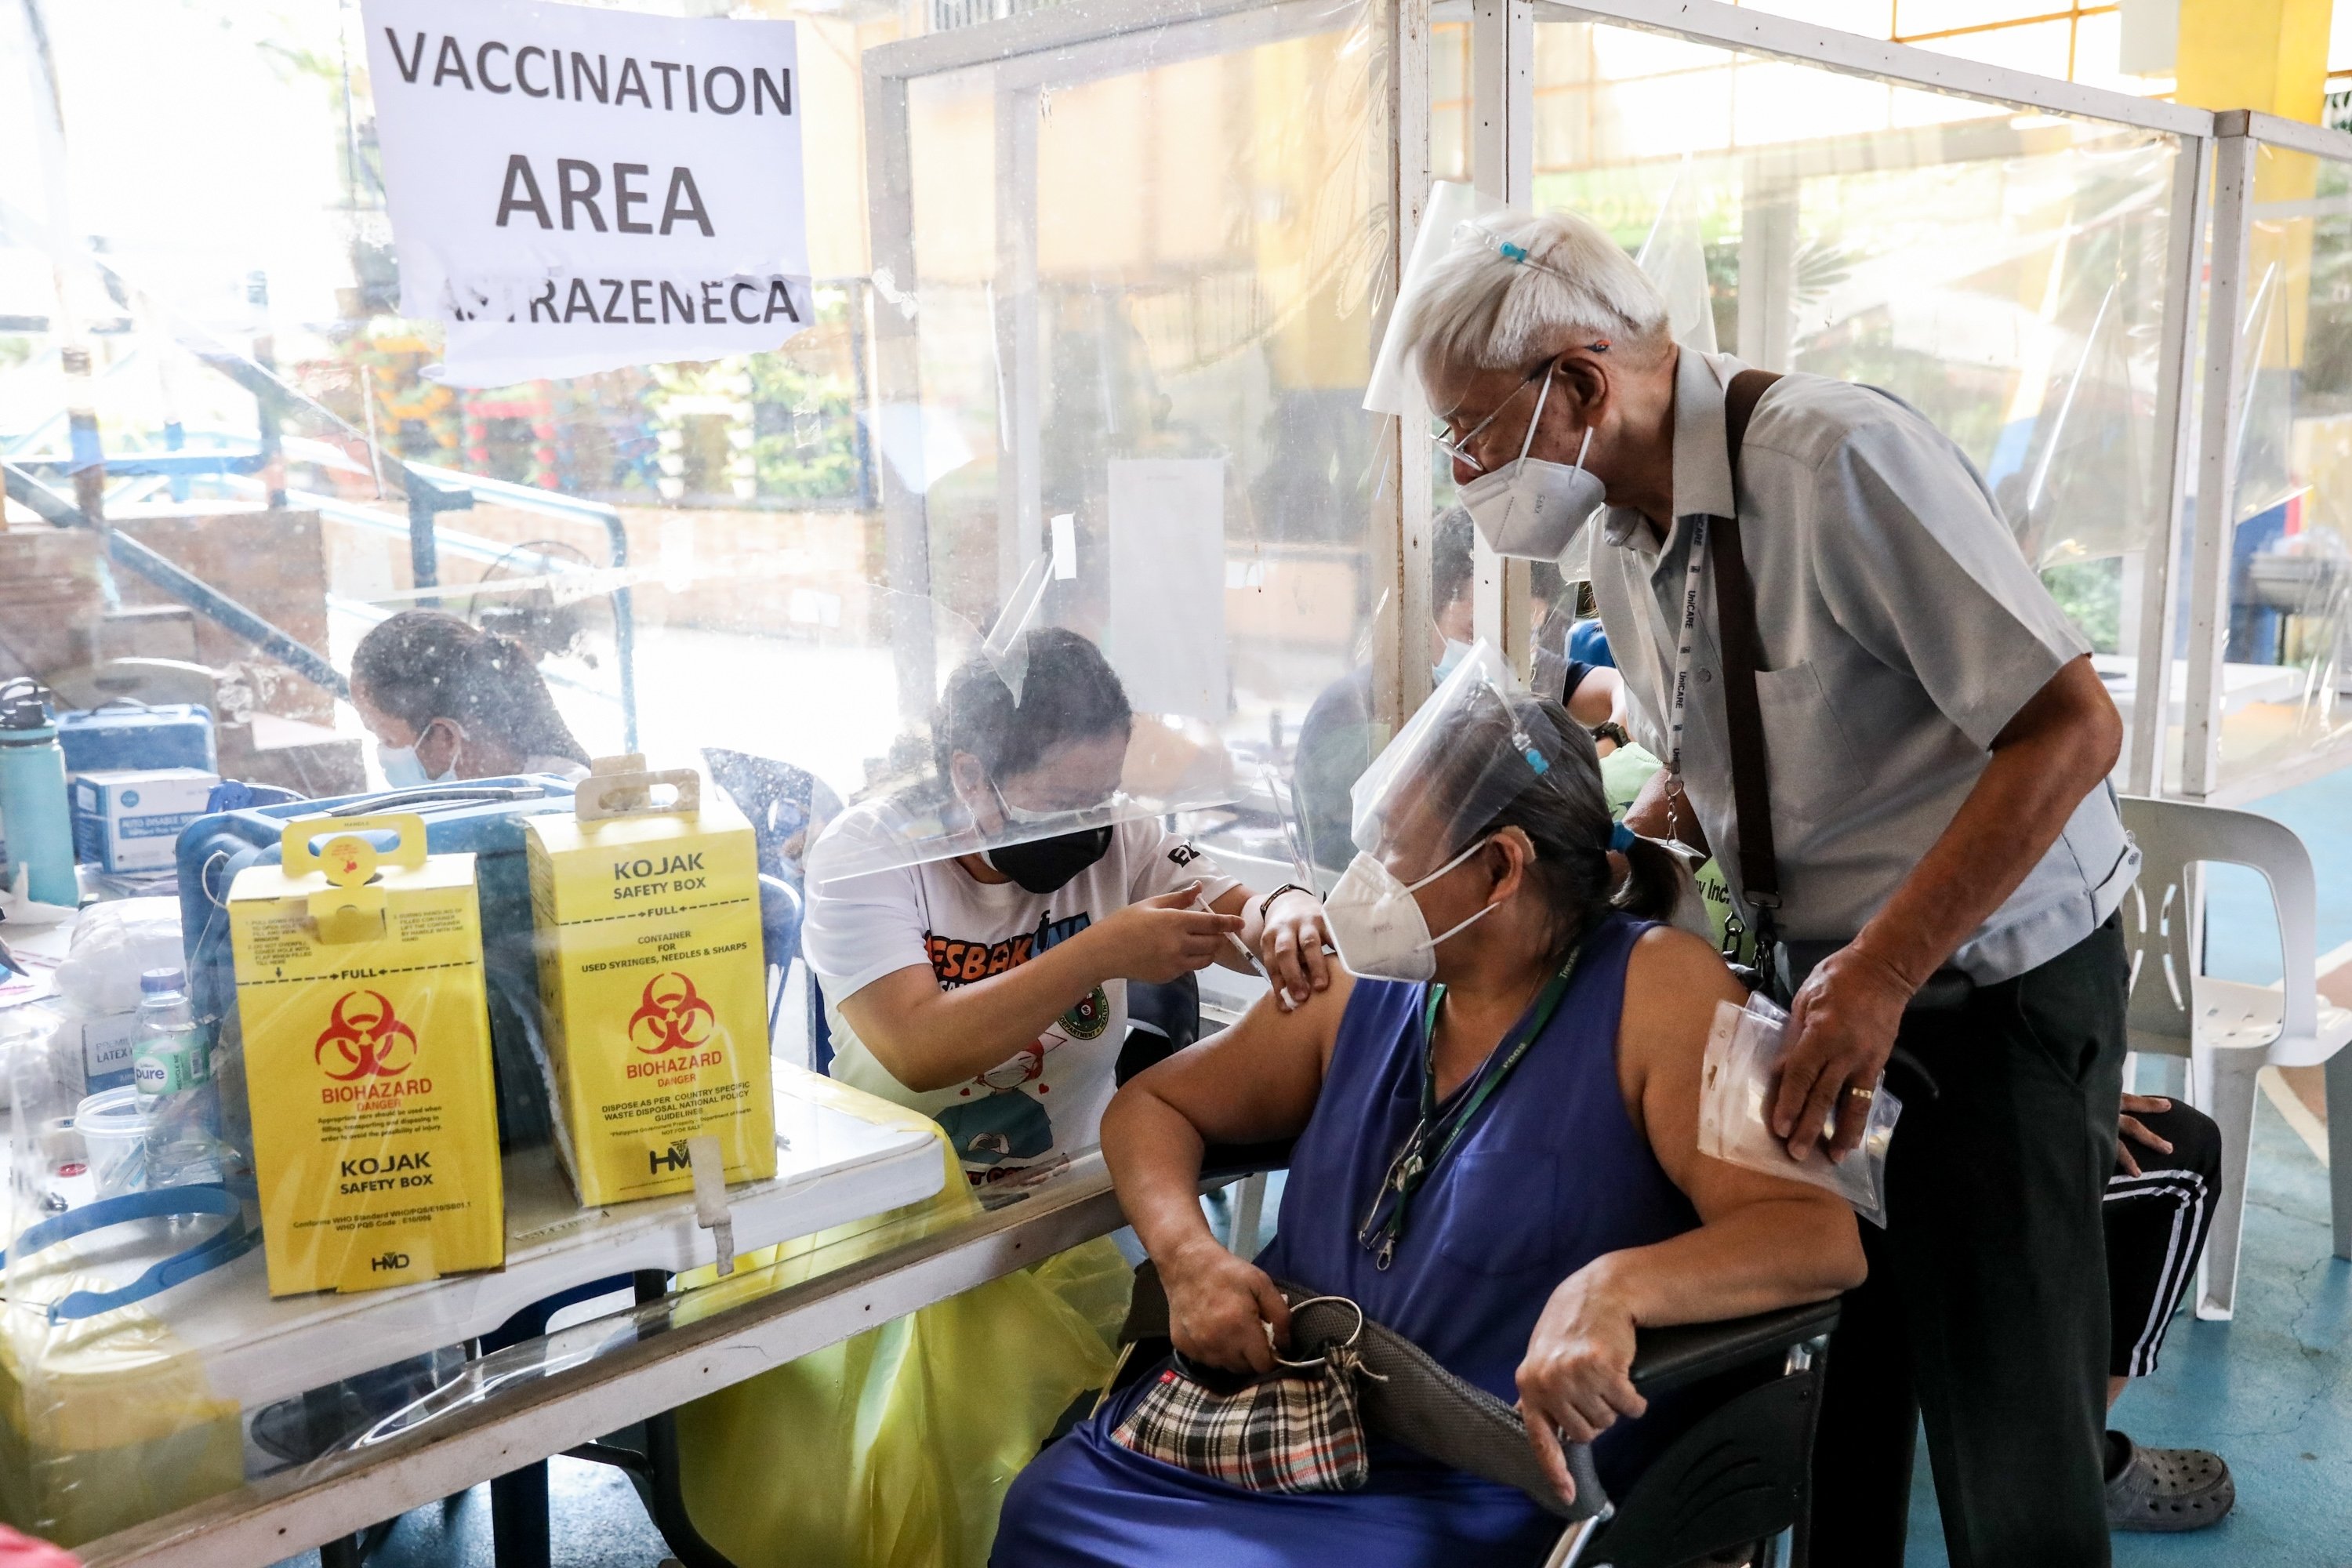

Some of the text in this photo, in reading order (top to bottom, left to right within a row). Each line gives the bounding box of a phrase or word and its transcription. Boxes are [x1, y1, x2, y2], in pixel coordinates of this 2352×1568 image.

[384, 27, 792, 116] VACCINATION
[495, 154, 715, 238] AREA
[445, 277, 800, 325] RAZENECA
[614, 852, 704, 880] KOJAK
[614, 877, 706, 899] SAFETY BOX
[1708, 878, 1730, 904] Inc.
[648, 906, 677, 916] FULL
[637, 931, 691, 944] CONTAINER
[658, 942, 676, 952] FOR
[582, 963, 607, 973] USED
[608, 956, 659, 969] SYRINGES,
[662, 950, 701, 963] NEEDLES
[713, 942, 747, 955] SHARPS
[341, 968, 377, 980] FULL
[96, 1048, 128, 1063] LATEX
[626, 1051, 722, 1079] BIOHAZARD
[136, 1068, 165, 1080] pure
[658, 1073, 696, 1087] DANGER
[321, 1078, 432, 1104] BIOHAZARD
[601, 1102, 638, 1113] DISPOSE
[674, 1089, 713, 1102] COUNTRY
[715, 1081, 750, 1094] SPECIFIC
[357, 1099, 401, 1112] DANGER
[604, 1090, 750, 1121] WASTE DISPOSAL NATIONAL POLICY
[655, 1108, 703, 1122] GUIDELINES
[341, 1152, 431, 1178] KOJAK
[650, 1146, 692, 1174] HM
[340, 1174, 434, 1195] SAFETY BOX
[336, 1223, 355, 1232] WHO
[354, 1212, 389, 1221] Standard
